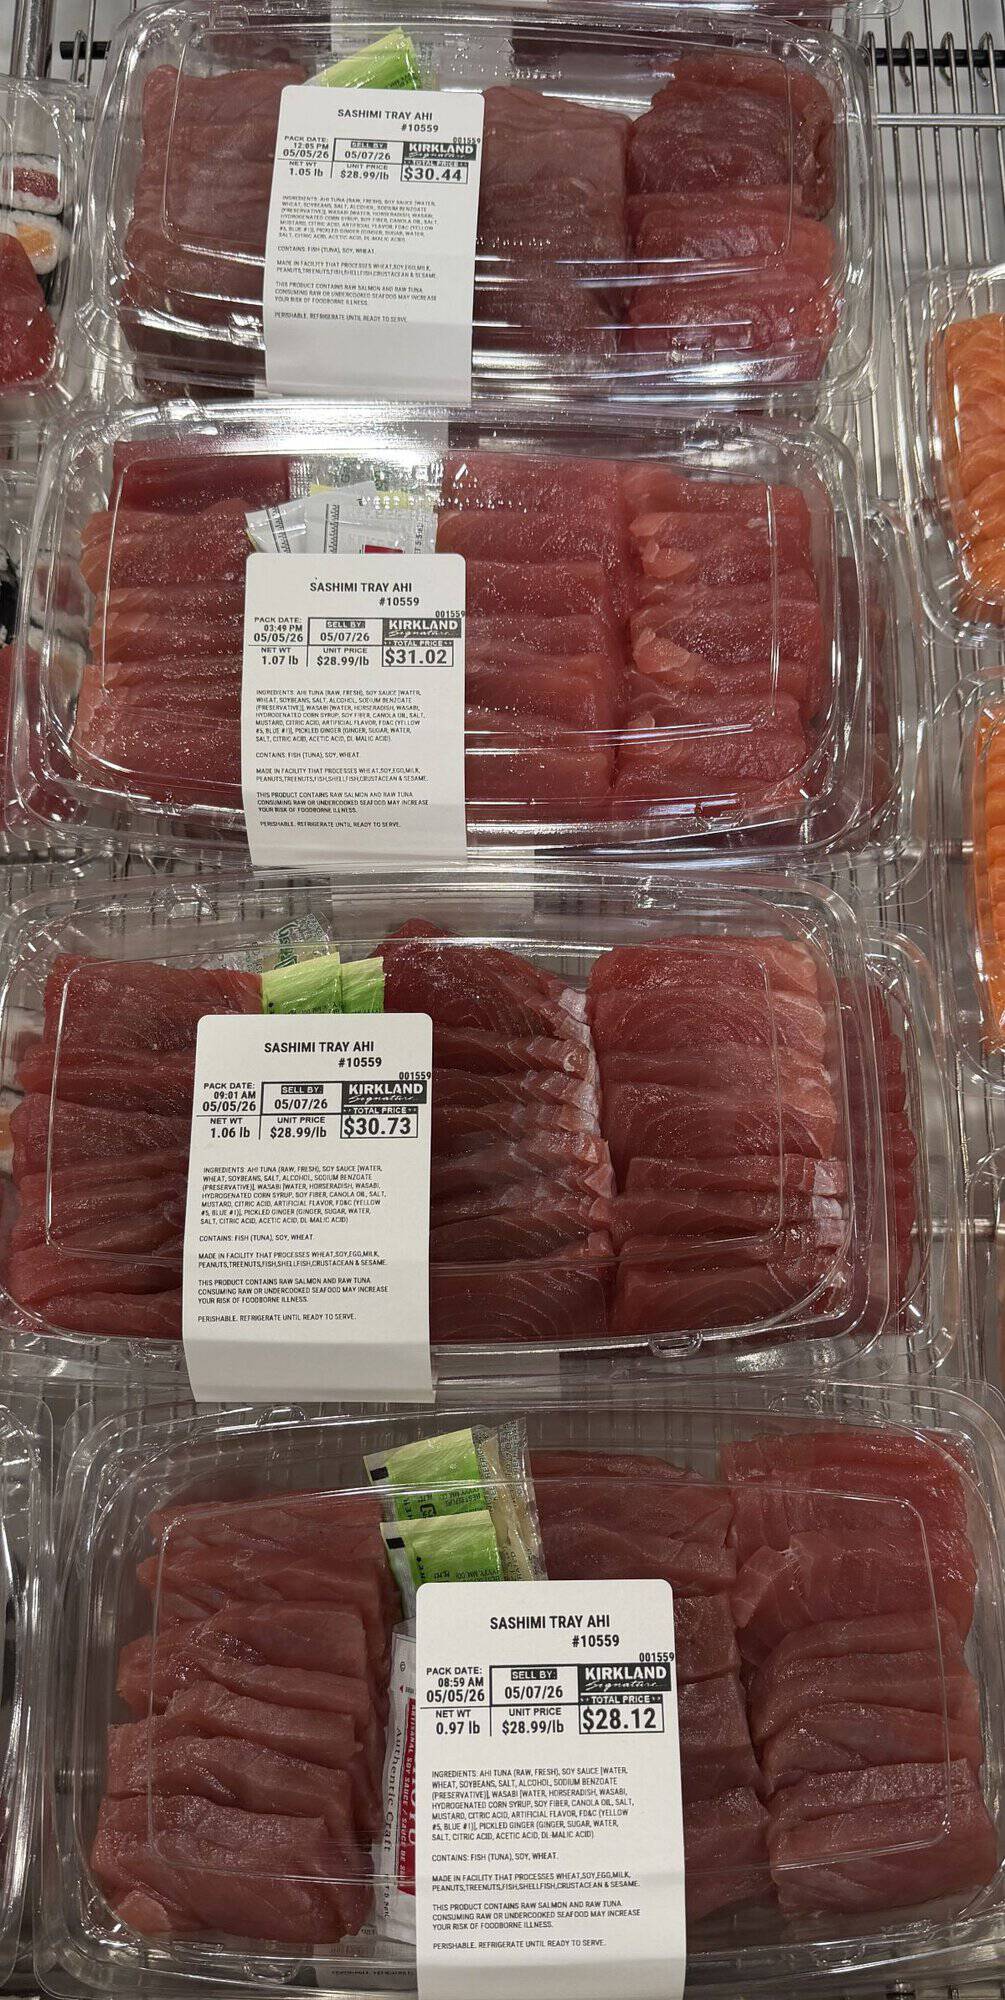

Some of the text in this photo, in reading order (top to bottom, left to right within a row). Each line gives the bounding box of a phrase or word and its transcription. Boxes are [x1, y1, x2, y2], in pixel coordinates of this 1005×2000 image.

[338, 109, 433, 121] SASHIMI TRAY AHI
[401, 124, 438, 132] #10559
[410, 144, 473, 153] KIRKLAND
[283, 149, 329, 159] 05/05/26
[345, 151, 390, 160] 05/07/26
[289, 168, 323, 177] 1.05 lb
[341, 170, 389, 180] $28.99/lb
[404, 167, 461, 182] $30.44
[310, 583, 412, 592] SASHIMI TRAY AHI
[379, 597, 419, 606] #10559
[389, 620, 458, 630] KIRKLAND
[254, 633, 303, 643] 05/05/26
[320, 633, 369, 642] 05/07/26
[262, 656, 298, 665] 1.07 lb
[317, 655, 369, 667] $28.99/lb
[385, 648, 447, 666] $31.02
[264, 1041, 374, 1053] SASHIMI TRAY AHI
[338, 1057, 382, 1068] #10559
[399, 1072, 431, 1080] 001559
[282, 1086, 303, 1094] SELL
[349, 1083, 423, 1095] KIRKLAND
[214, 1091, 256, 1099] 09:01 AM
[202, 1101, 256, 1112] 05/05/26
[275, 1099, 327, 1110] 05/07/26
[344, 1116, 411, 1137] $30.73
[210, 1127, 250, 1138] 1.06 lb
[270, 1126, 326, 1138] $28.99/lb
[490, 1615, 610, 1630] SASHIMI TRAY AHI
[572, 1634, 620, 1648] #10559
[639, 1652, 674, 1662] 001559
[427, 1667, 482, 1675] PACK DATE:
[512, 1671, 537, 1679] SELL
[585, 1667, 667, 1680] KIRKLAND
[438, 1678, 483, 1688] 08:59 AM
[427, 1690, 485, 1703] 05/05/26
[505, 1686, 563, 1700] 05/07/26
[623, 1695, 650, 1703] PRICE
[436, 1709, 471, 1718] NET WT
[509, 1707, 561, 1716] UNIT PRICE
[583, 1706, 656, 1732] $28.12
[436, 1721, 480, 1734] 0.97 lb
[502, 1718, 564, 1735] $28.99/lb
[404, 1756, 413, 1776] SOY
[554, 1778, 580, 1786] SODIUM
[582, 1777, 617, 1786] BENZOATE
[382, 1727, 403, 1852] Authentic Craft
[401, 1777, 411, 1807] SAUCE
[399, 1817, 409, 1848] SAUCE
[471, 1853, 486, 1861] FISH
[463, 1874, 492, 1882] FACILITY
[450, 1903, 481, 1911] PRODUCT
[484, 1902, 519, 1910] CONTAINS
[538, 1901, 568, 1909] SALMON
[433, 1913, 474, 1921] CONSUMING
[476, 1912, 492, 1920] RAW
[505, 1911, 555, 1919] UNDERCOOKED
[557, 1910, 589, 1918] SEAFOOD
[608, 1909, 640, 1917] INCREASE
[433, 1923, 451, 1931] YOUR
[453, 1922, 468, 1930] RISK
[480, 1921, 522, 1929] FOODBORNE
[526, 1940, 545, 1948] UNTIL
[547, 1939, 569, 1947] READY
[571, 1939, 581, 1947] TO
